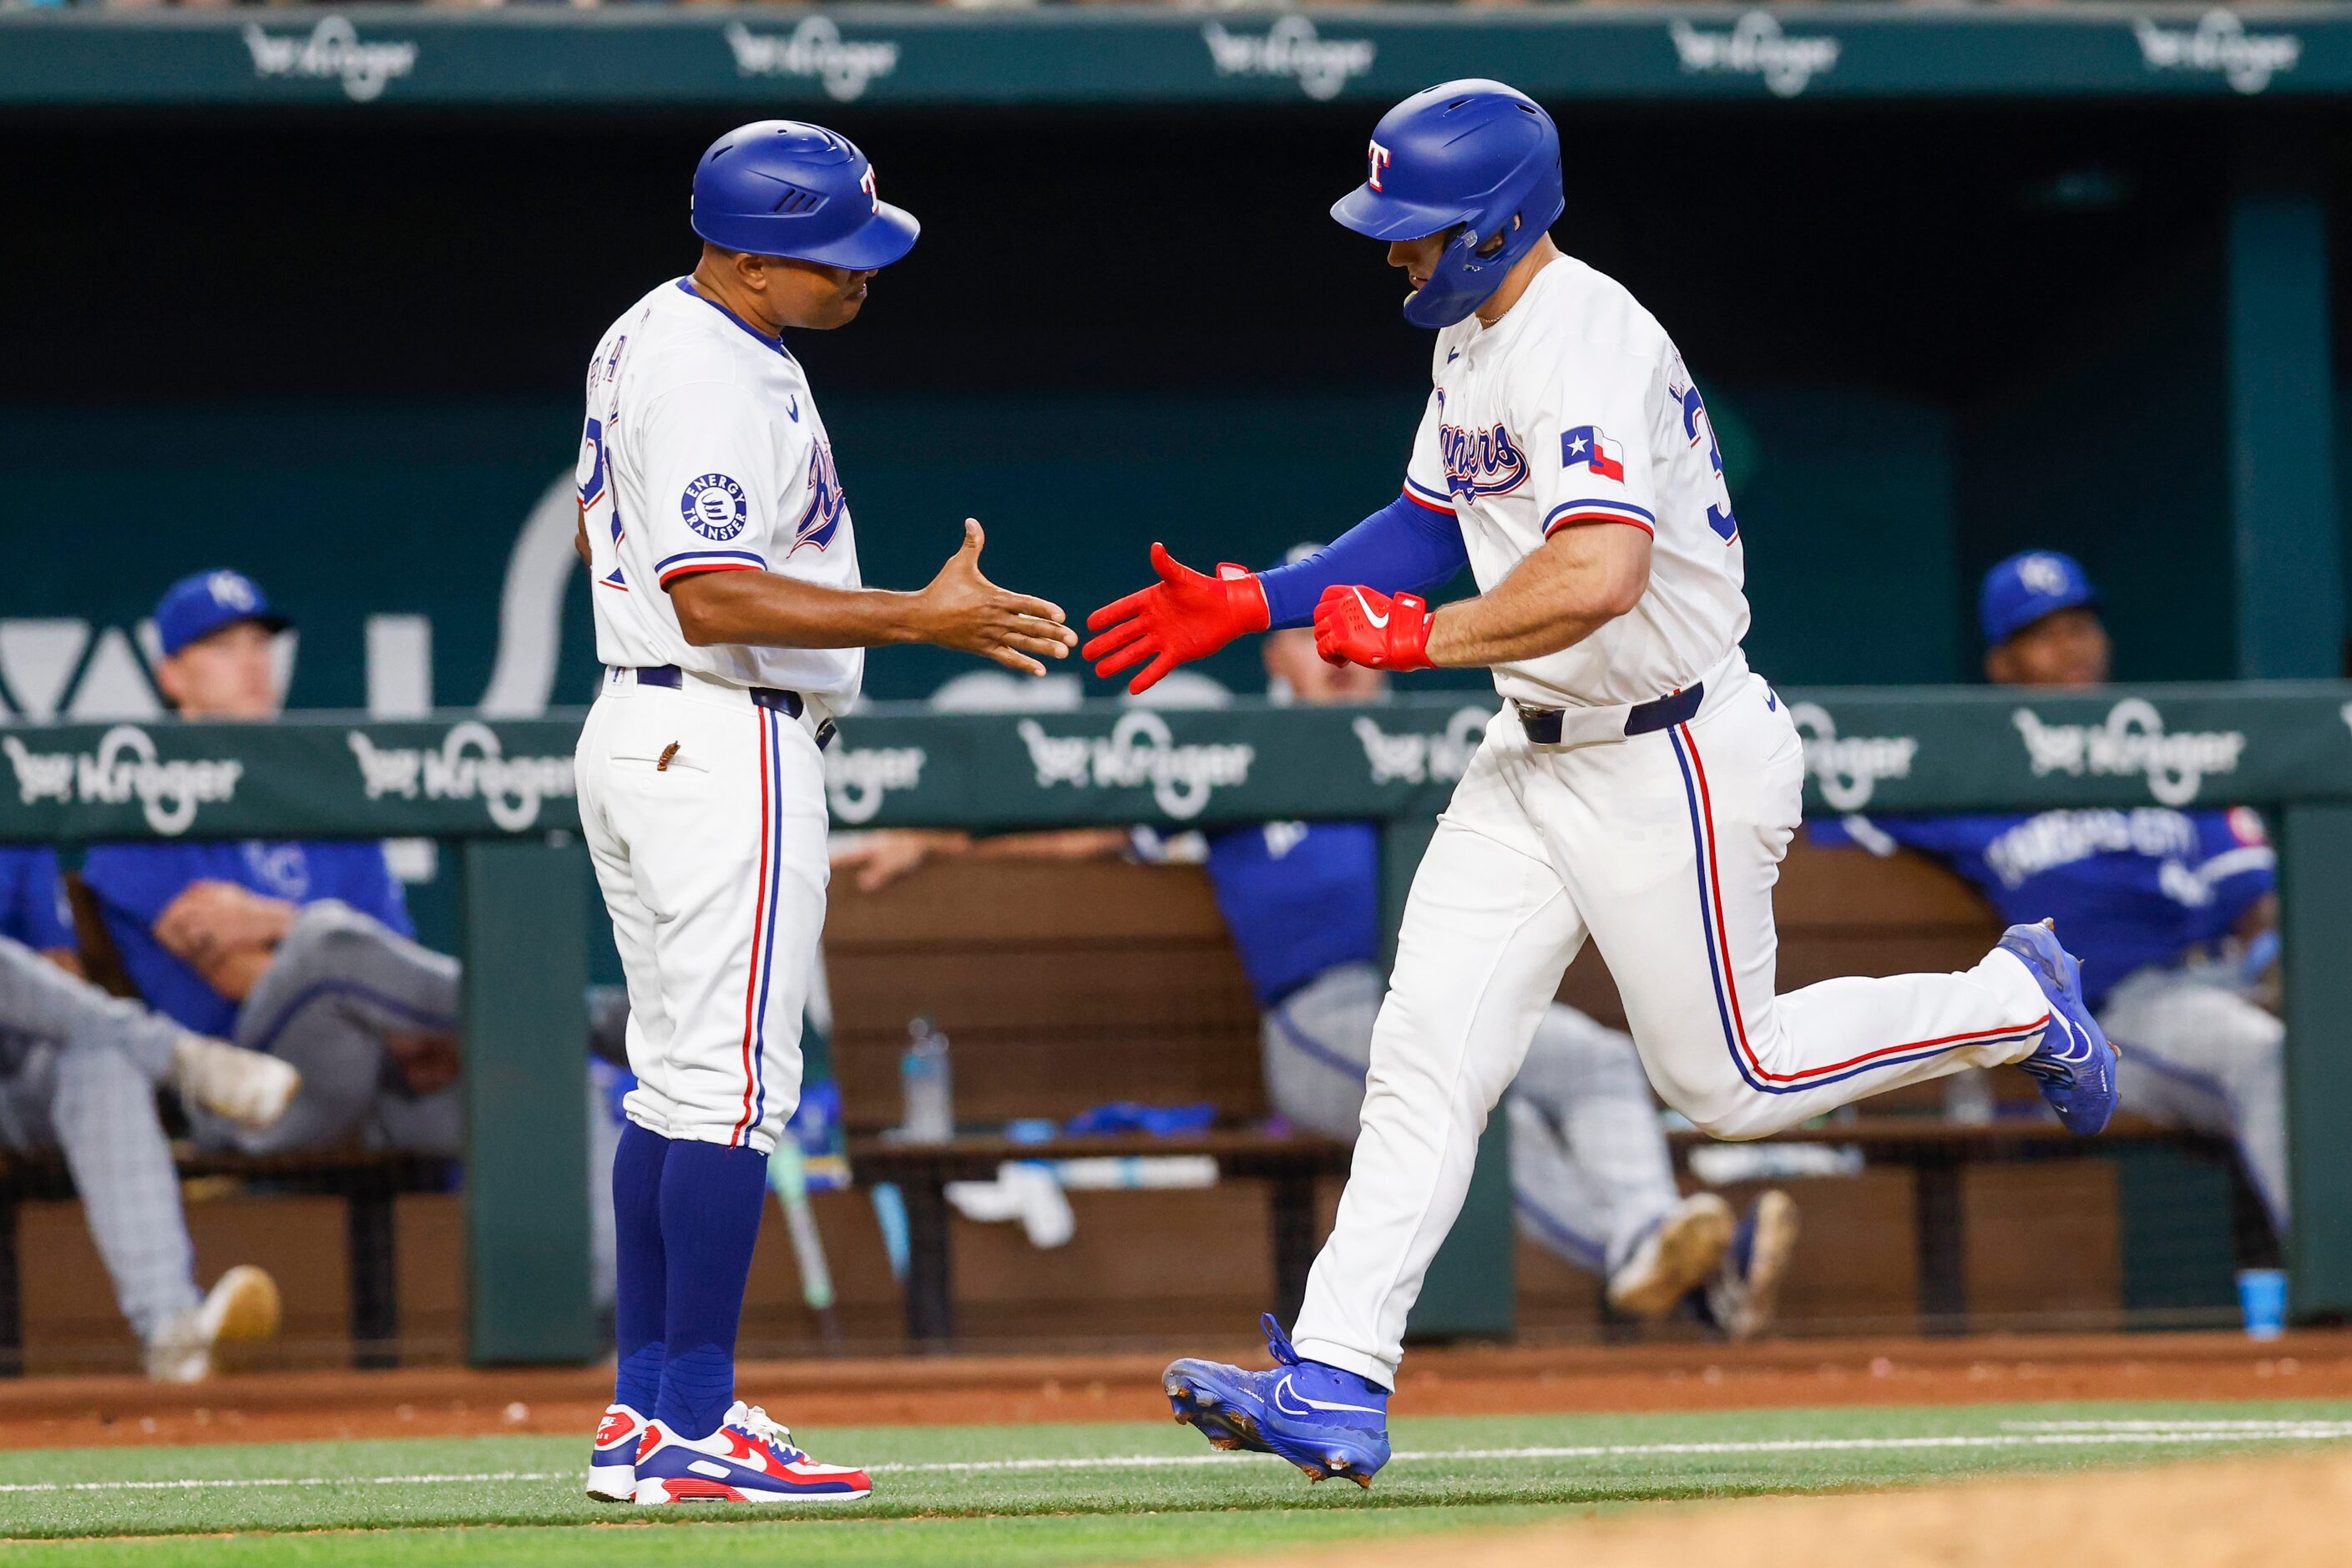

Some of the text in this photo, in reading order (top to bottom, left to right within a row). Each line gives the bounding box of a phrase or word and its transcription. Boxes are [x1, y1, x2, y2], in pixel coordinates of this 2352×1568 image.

[1368, 139, 1391, 192] T
[685, 474, 746, 503] ENERGY
[683, 507, 746, 541] TRANSFER
